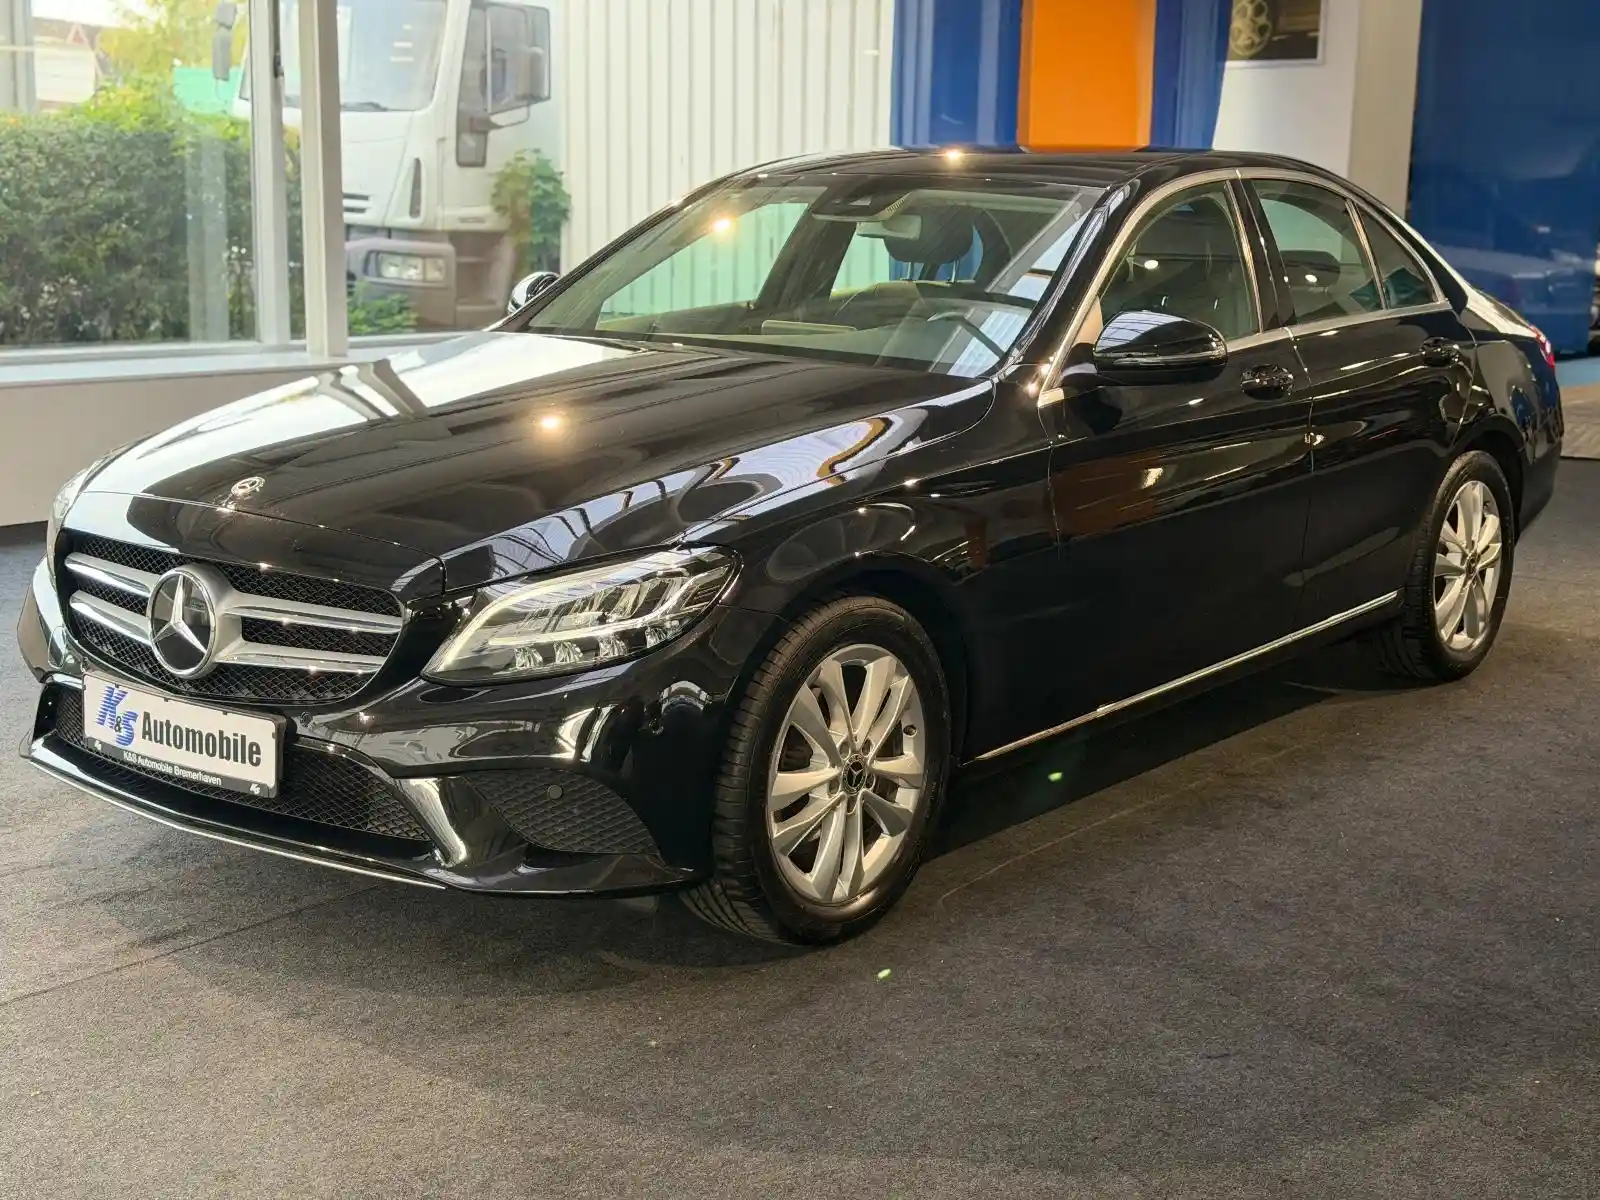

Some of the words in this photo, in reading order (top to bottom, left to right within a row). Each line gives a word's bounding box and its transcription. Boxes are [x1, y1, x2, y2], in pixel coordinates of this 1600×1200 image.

[96, 685, 138, 746] K&S
[142, 711, 261, 767] Automobile
[138, 756, 173, 774] Automobile
[174, 765, 222, 786] Bremerhaven
